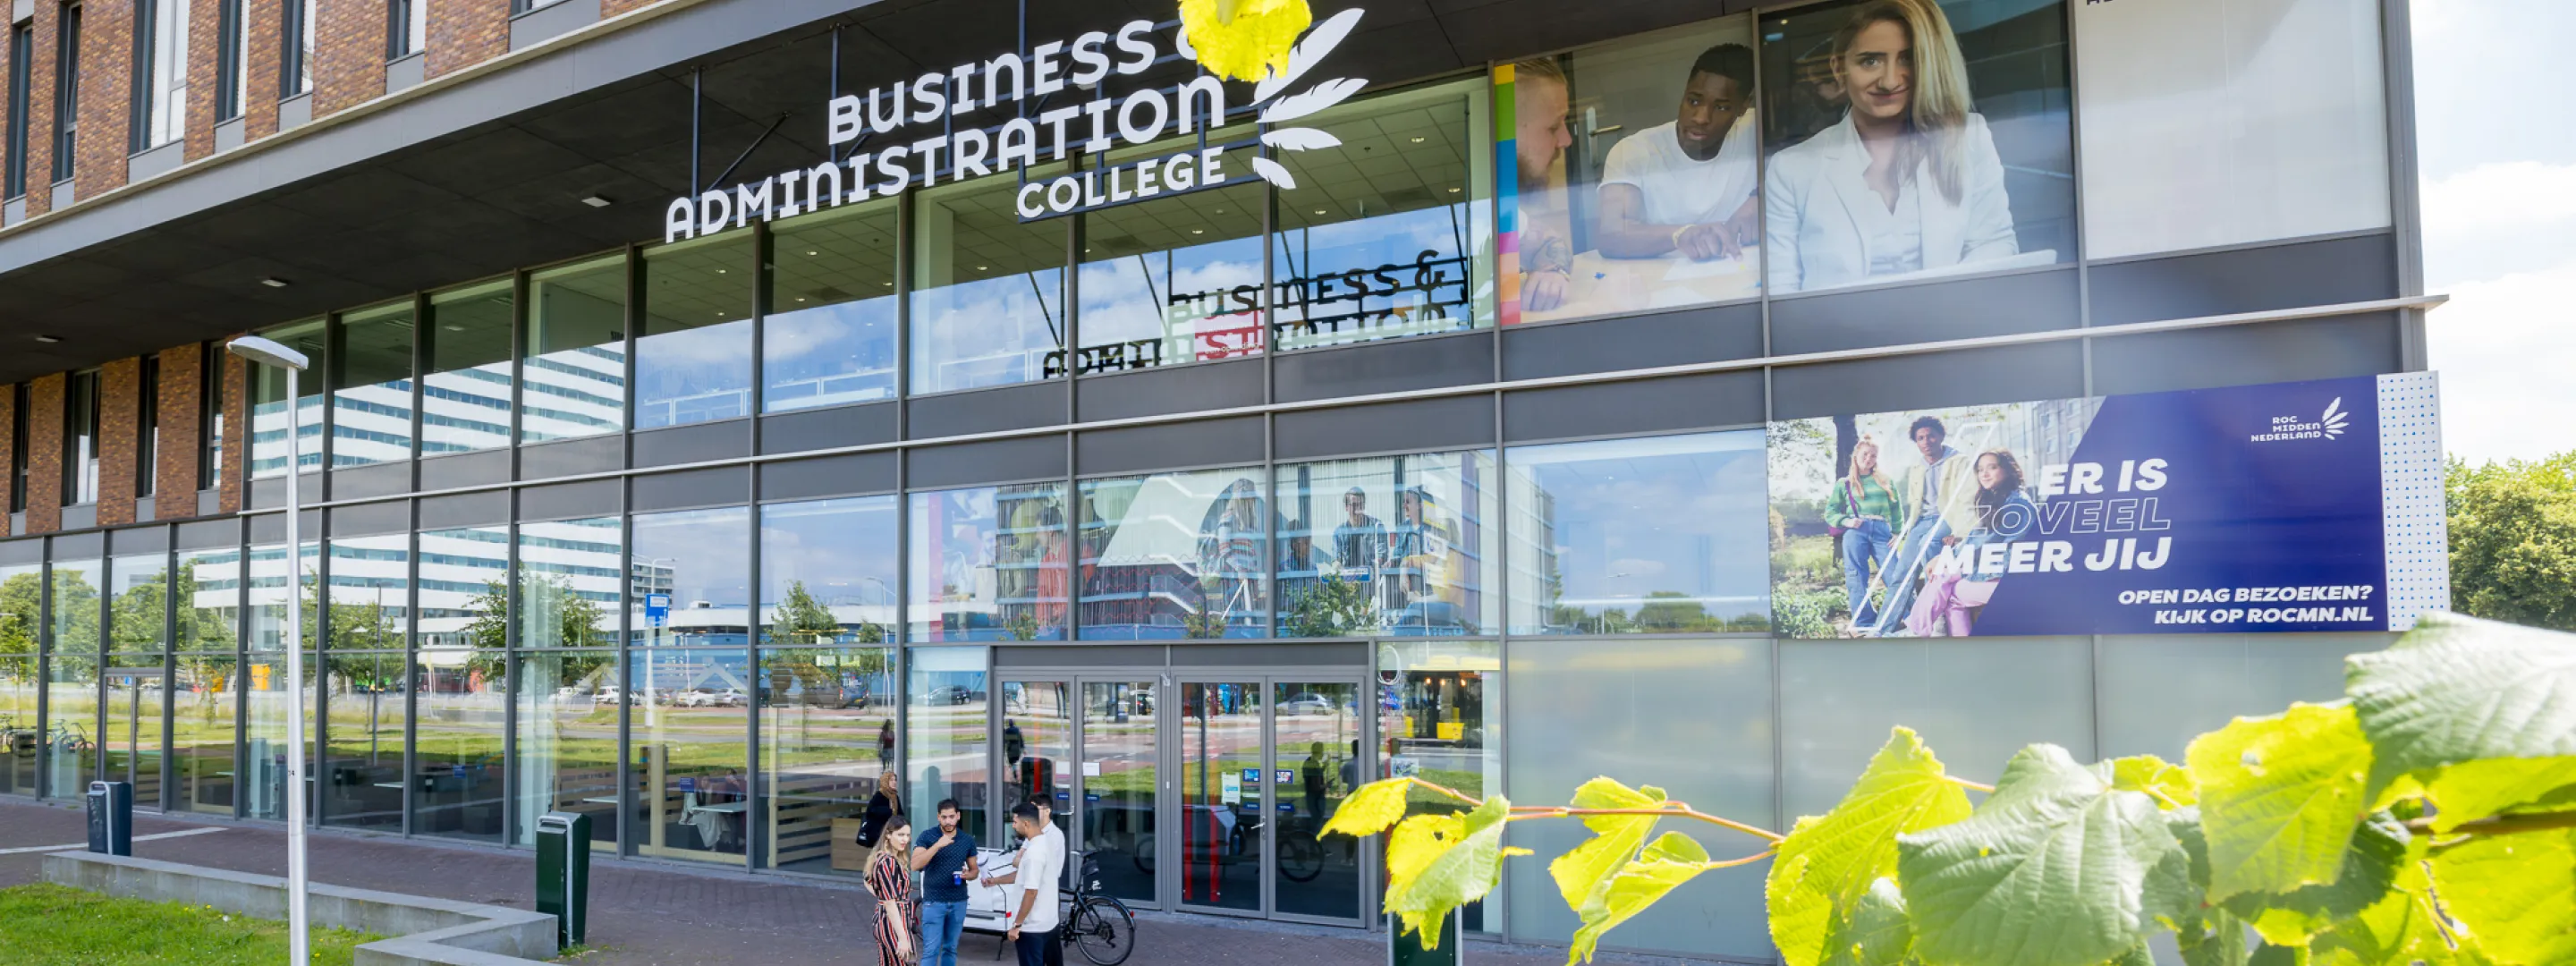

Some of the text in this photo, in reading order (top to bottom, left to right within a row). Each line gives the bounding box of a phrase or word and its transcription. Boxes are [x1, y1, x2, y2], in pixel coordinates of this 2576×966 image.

[828, 20, 1156, 145] BUSINESS
[665, 75, 1224, 243] ADMINISTRATION
[1017, 146, 1225, 218] COLLEGE
[2250, 430, 2322, 442] NEDERLAND
[2272, 415, 2298, 424] ROC
[2272, 422, 2321, 433] MIDDEN
[2038, 458, 2168, 496] ER IS
[1970, 497, 2171, 537] ZOVEEL
[1933, 536, 2172, 575] MEER JIJ
[2118, 585, 2373, 605] OPEN DAG BEZOEKEN?
[2154, 606, 2374, 624] KIJK OP ROCMN.NL
